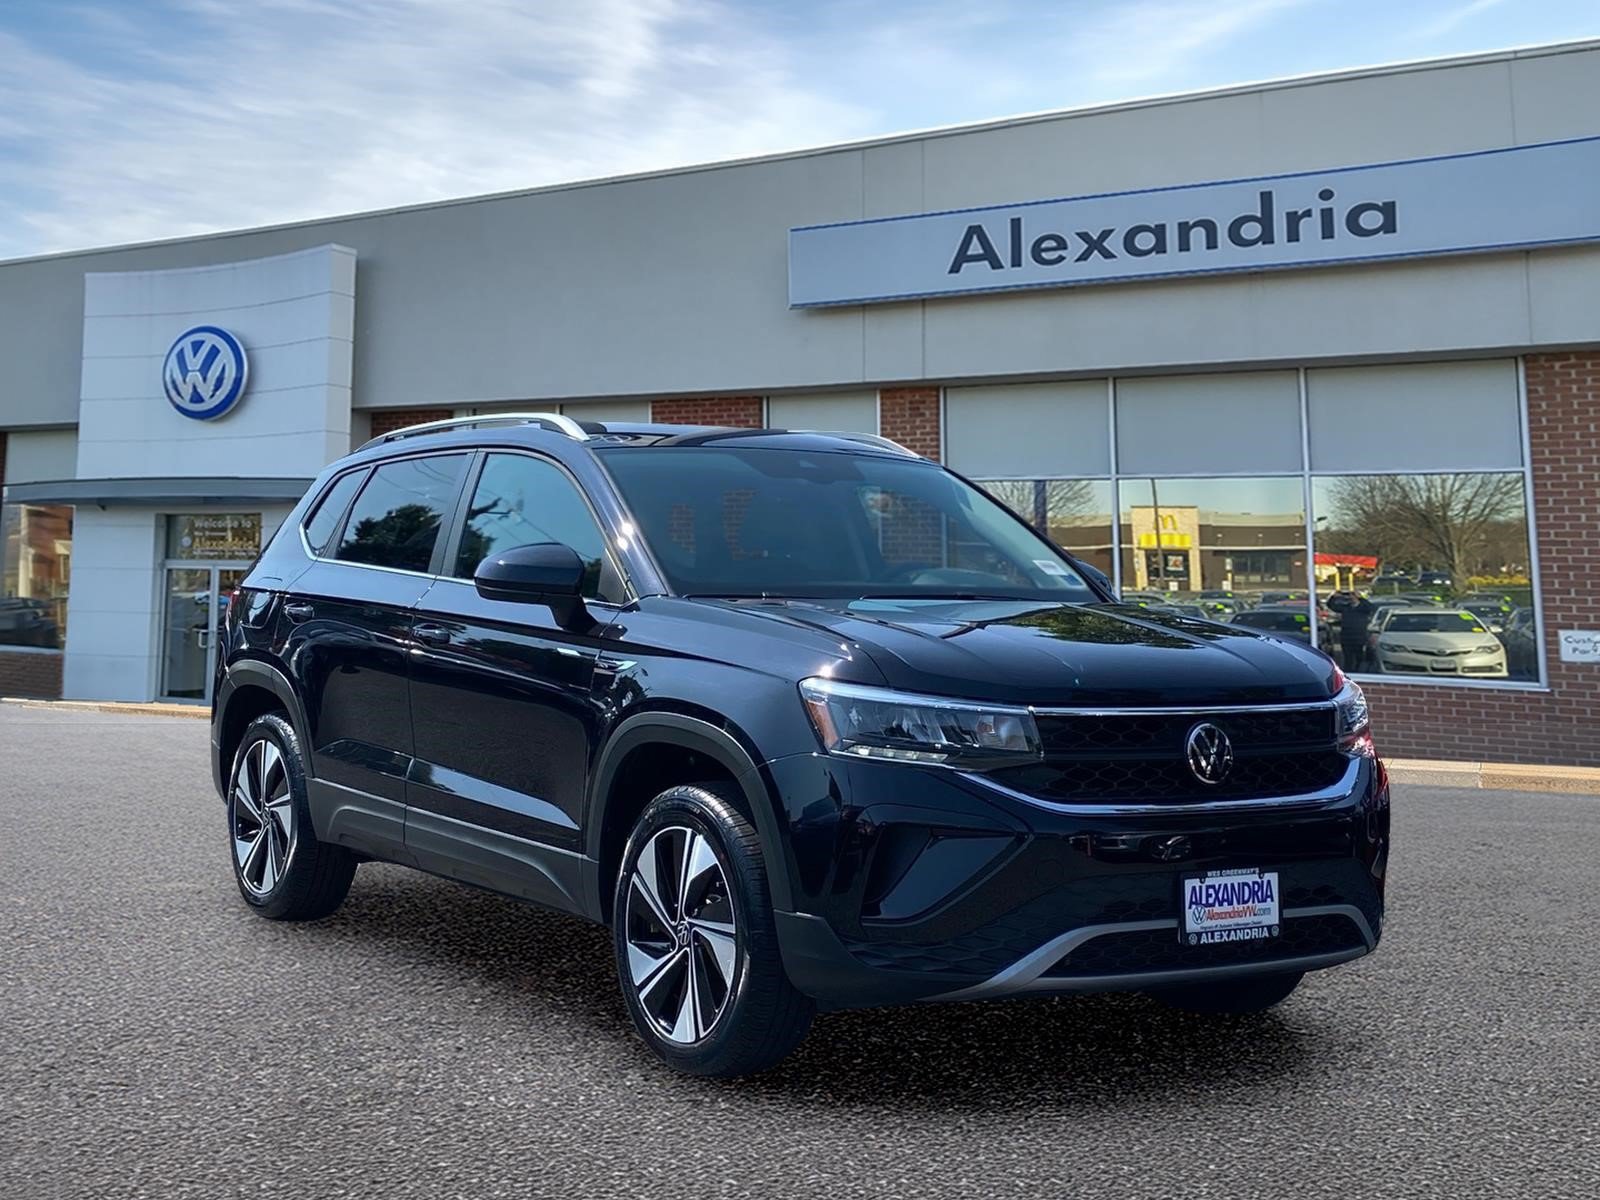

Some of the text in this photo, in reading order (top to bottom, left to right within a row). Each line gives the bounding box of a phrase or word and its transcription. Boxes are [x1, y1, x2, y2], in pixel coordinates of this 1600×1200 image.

[947, 188, 1398, 274] Alexandria
[165, 329, 242, 414] VW
[1188, 879, 1274, 910] ALEXANDRIA
[1200, 927, 1269, 944] ALEXANDRIA
